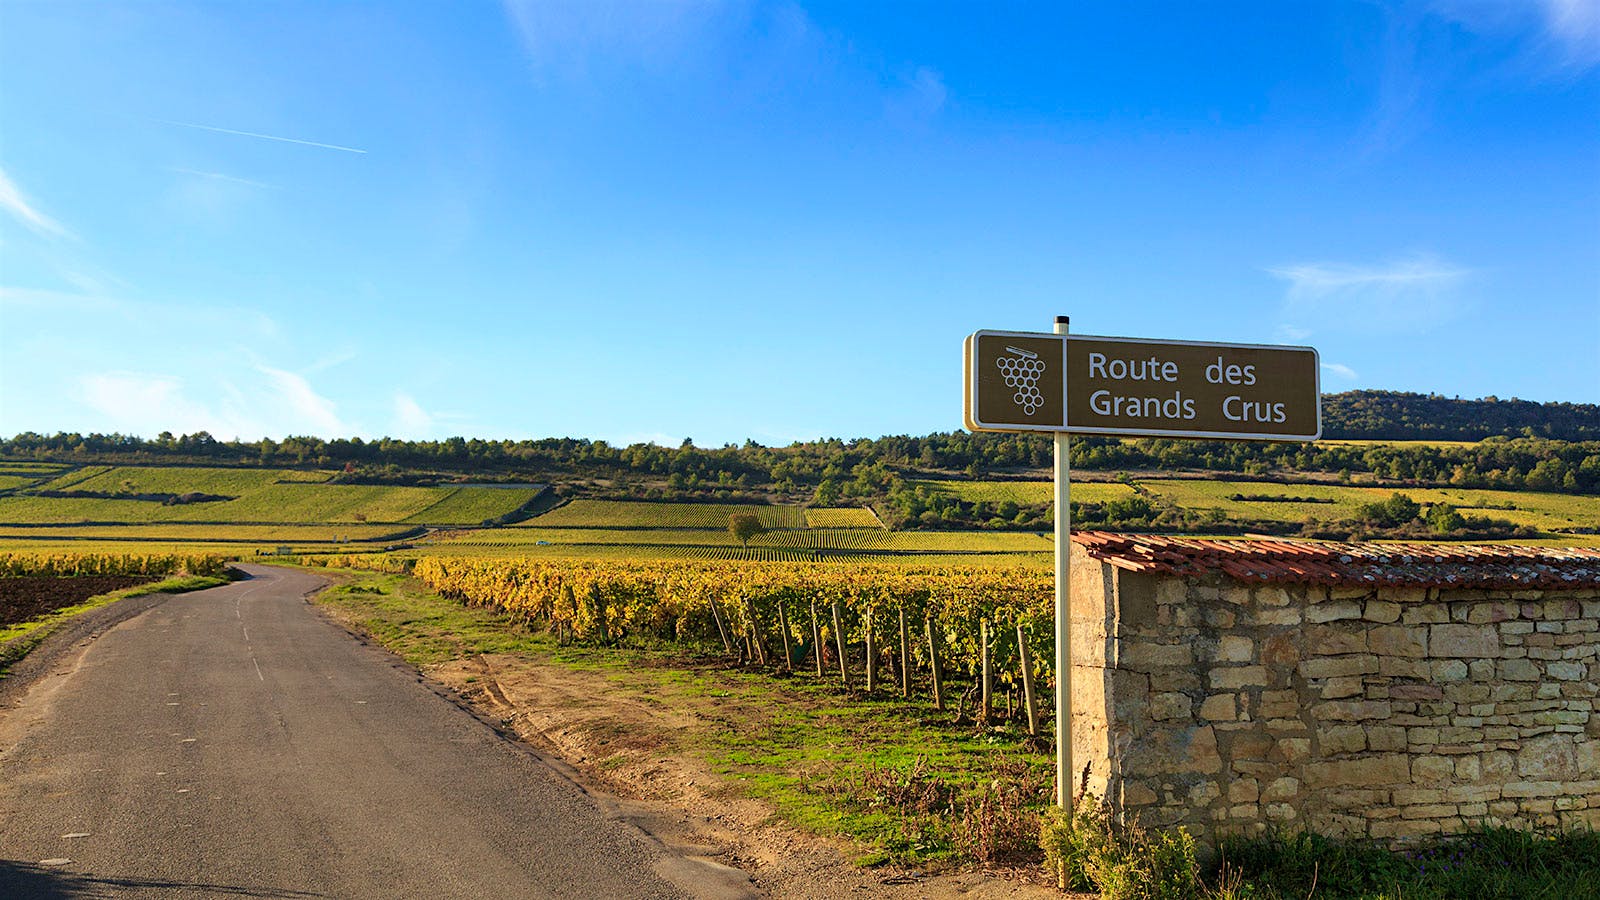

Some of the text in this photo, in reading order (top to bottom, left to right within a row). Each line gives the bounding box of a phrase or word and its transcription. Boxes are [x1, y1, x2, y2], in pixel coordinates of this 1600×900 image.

[1089, 352, 1256, 385] Route des
[1089, 390, 1286, 423] Grands Crus
